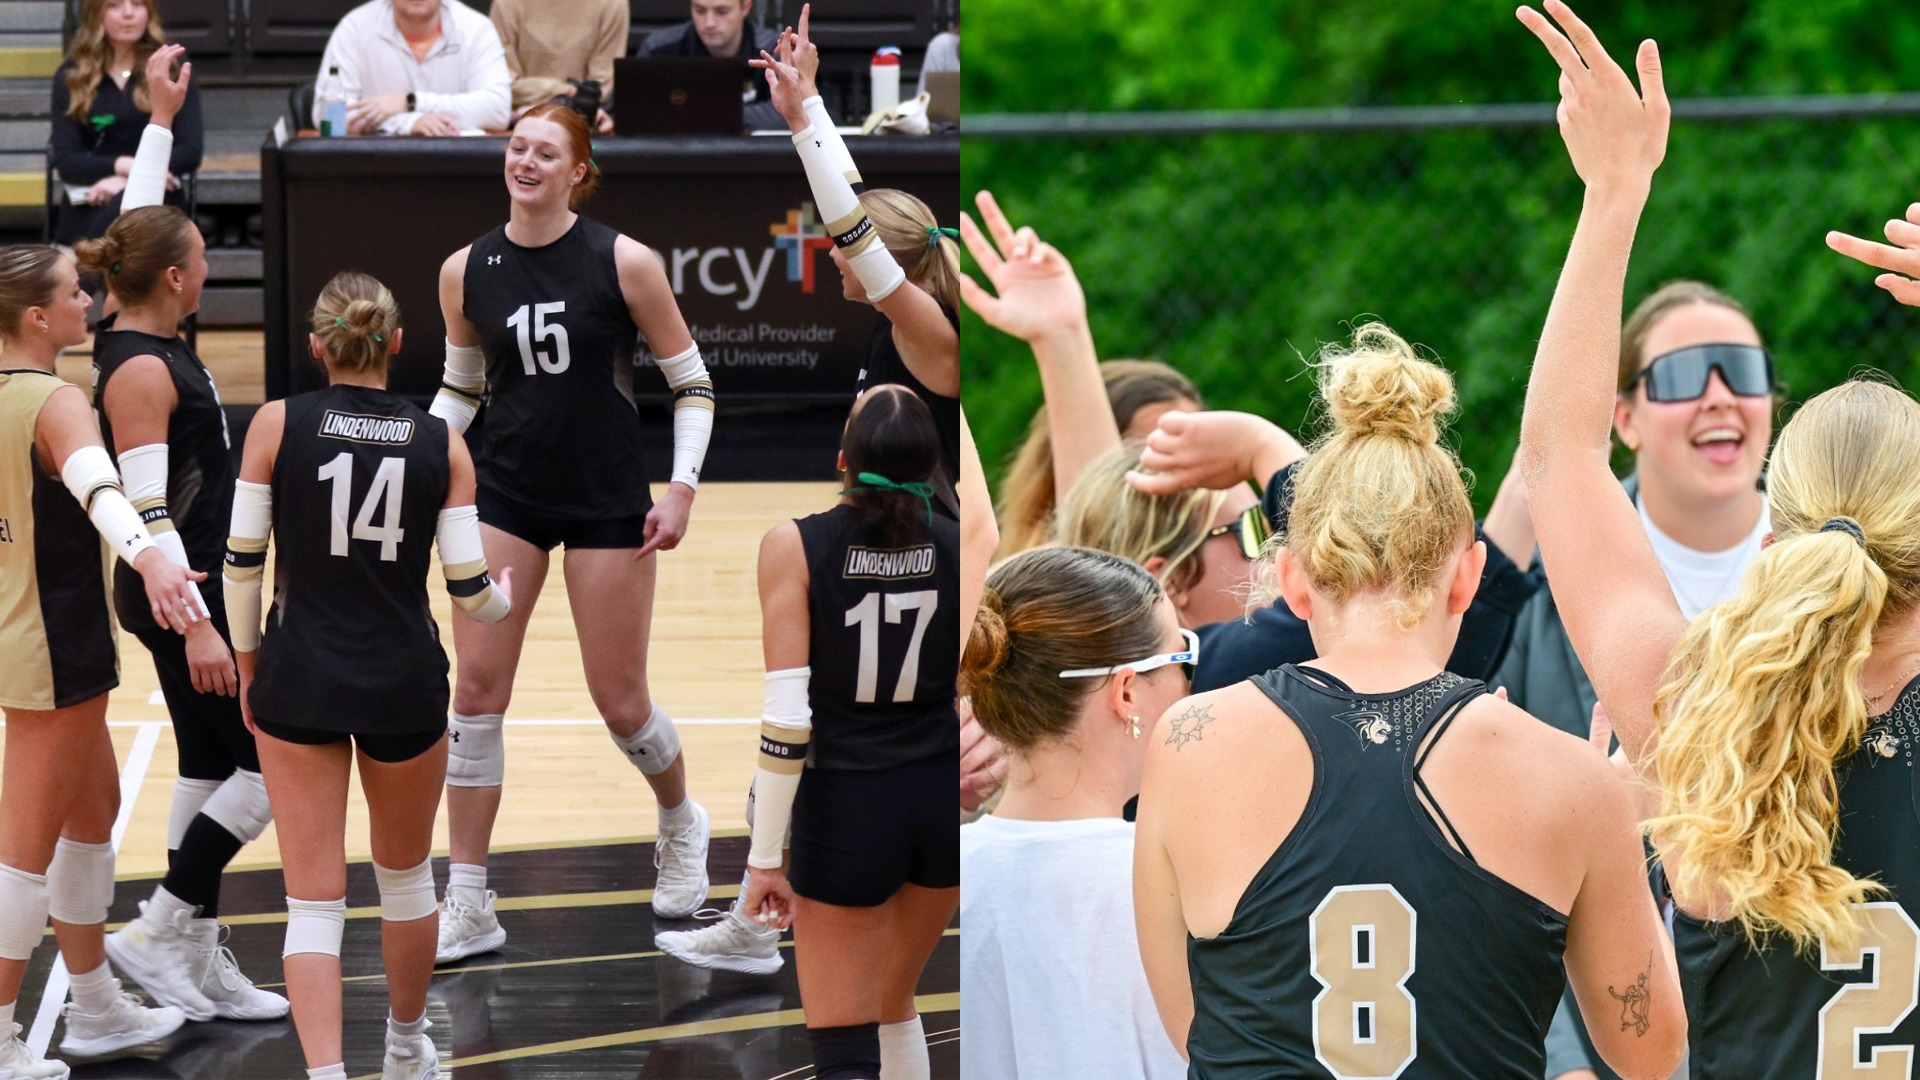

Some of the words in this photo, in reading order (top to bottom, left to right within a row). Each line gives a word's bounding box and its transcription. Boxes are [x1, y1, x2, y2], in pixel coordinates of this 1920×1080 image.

[653, 246, 776, 311] rcy
[507, 301, 571, 375] 15
[724, 349, 819, 370] University
[759, 324, 836, 342] Provider
[323, 413, 411, 442] LINDENWOOD
[318, 452, 406, 562] 14
[848, 548, 933, 576] LINDENWOOD
[845, 590, 938, 703] 17
[1309, 883, 1417, 1080] 8
[1816, 902, 1920, 1080] 2
